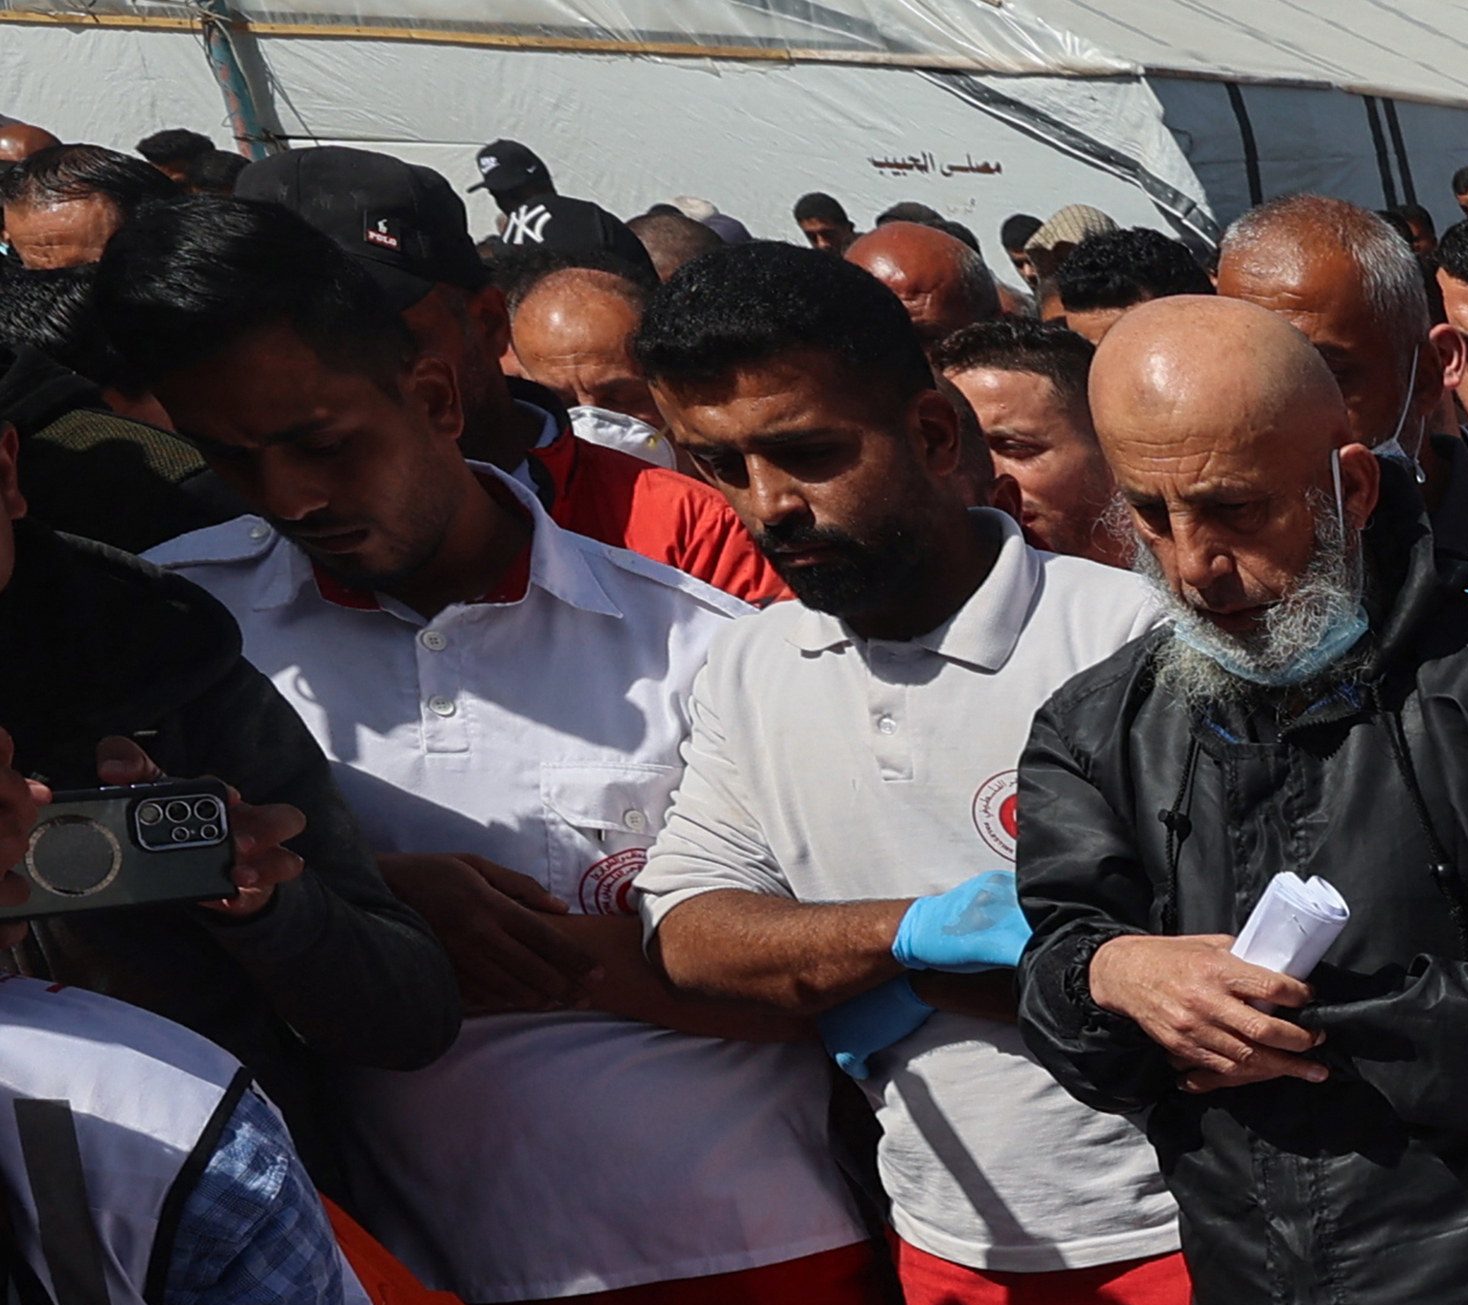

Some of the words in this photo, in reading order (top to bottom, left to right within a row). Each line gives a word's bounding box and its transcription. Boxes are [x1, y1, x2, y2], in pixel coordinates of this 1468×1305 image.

[867, 151, 936, 177] الحبيب
[940, 153, 1003, 177] مصلى
[366, 230, 398, 247] POLO
